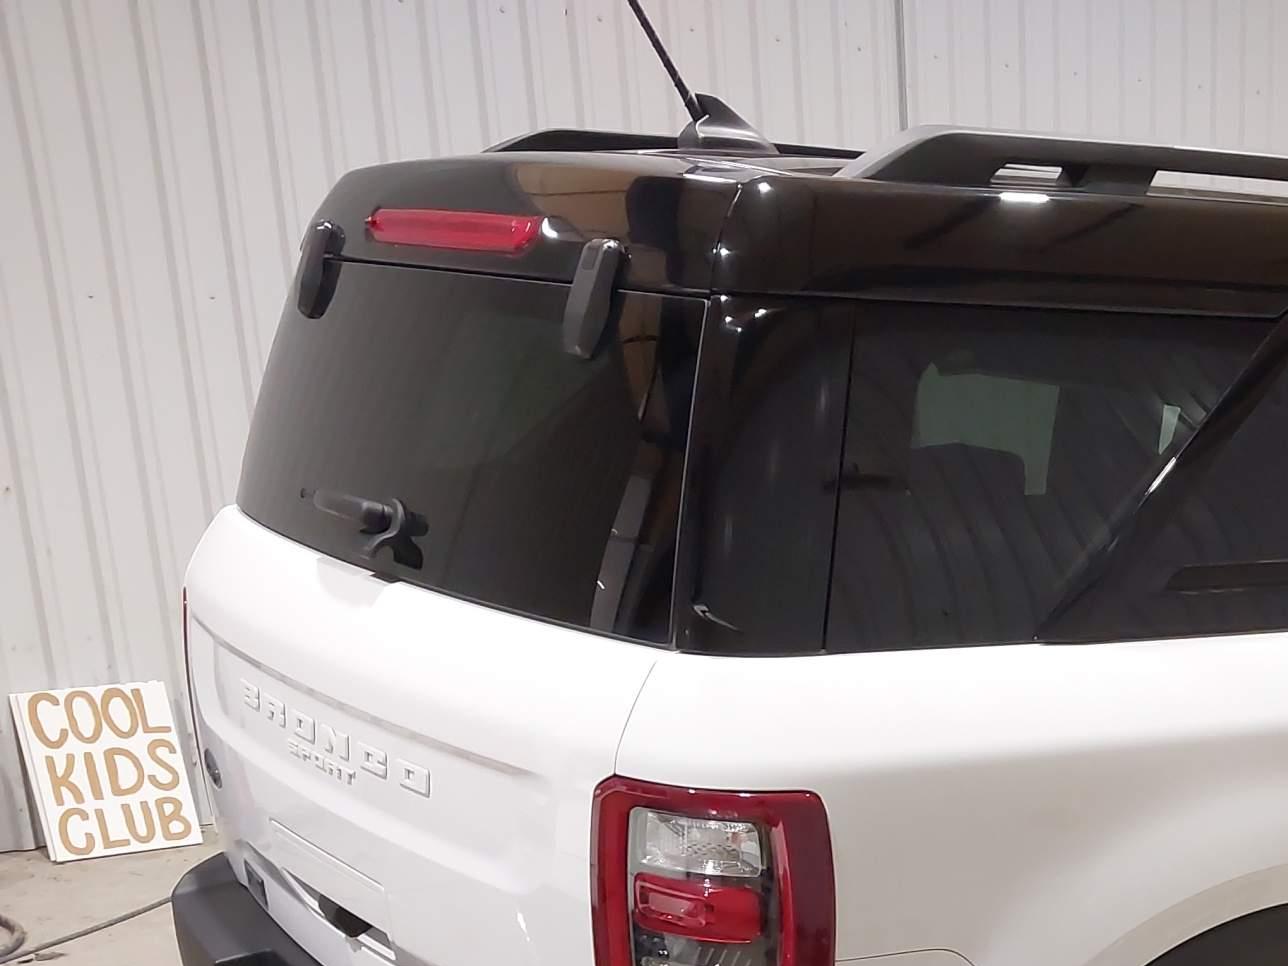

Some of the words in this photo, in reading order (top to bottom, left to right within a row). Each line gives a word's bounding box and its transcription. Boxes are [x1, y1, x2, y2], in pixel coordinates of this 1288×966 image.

[28, 688, 172, 749] COOL
[239, 677, 431, 798] BRONCO
[45, 739, 180, 806] KIDS
[287, 736, 356, 785] SPORT
[58, 797, 192, 856] CLUB
